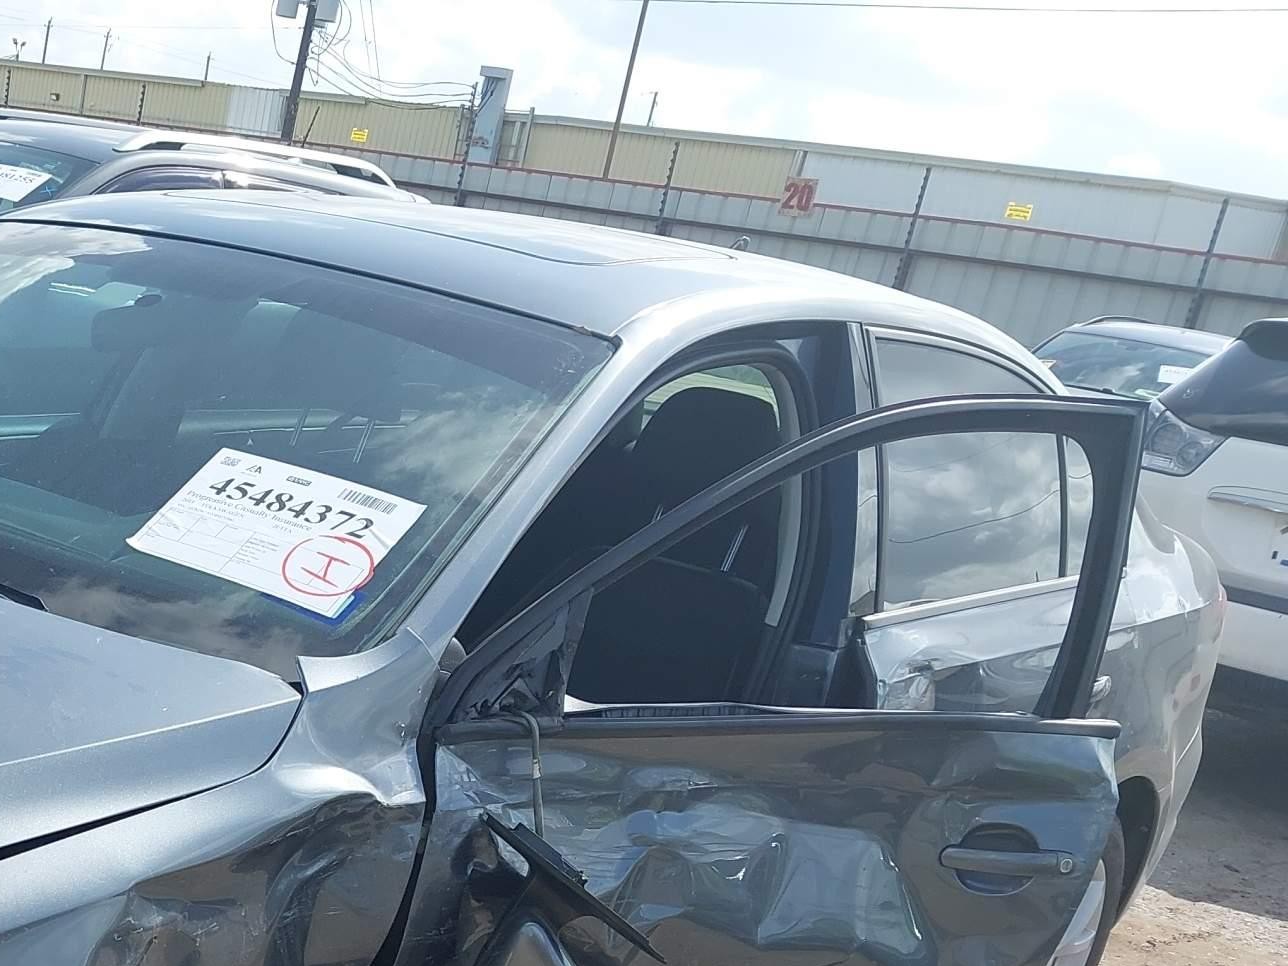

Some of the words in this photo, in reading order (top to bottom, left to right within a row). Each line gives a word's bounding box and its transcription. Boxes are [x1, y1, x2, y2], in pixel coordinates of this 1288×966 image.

[781, 182, 814, 211] 20
[186, 489, 234, 509] Progressive
[234, 502, 270, 520] Casualty
[271, 513, 313, 531] Insurance
[208, 477, 374, 539] 45484372
